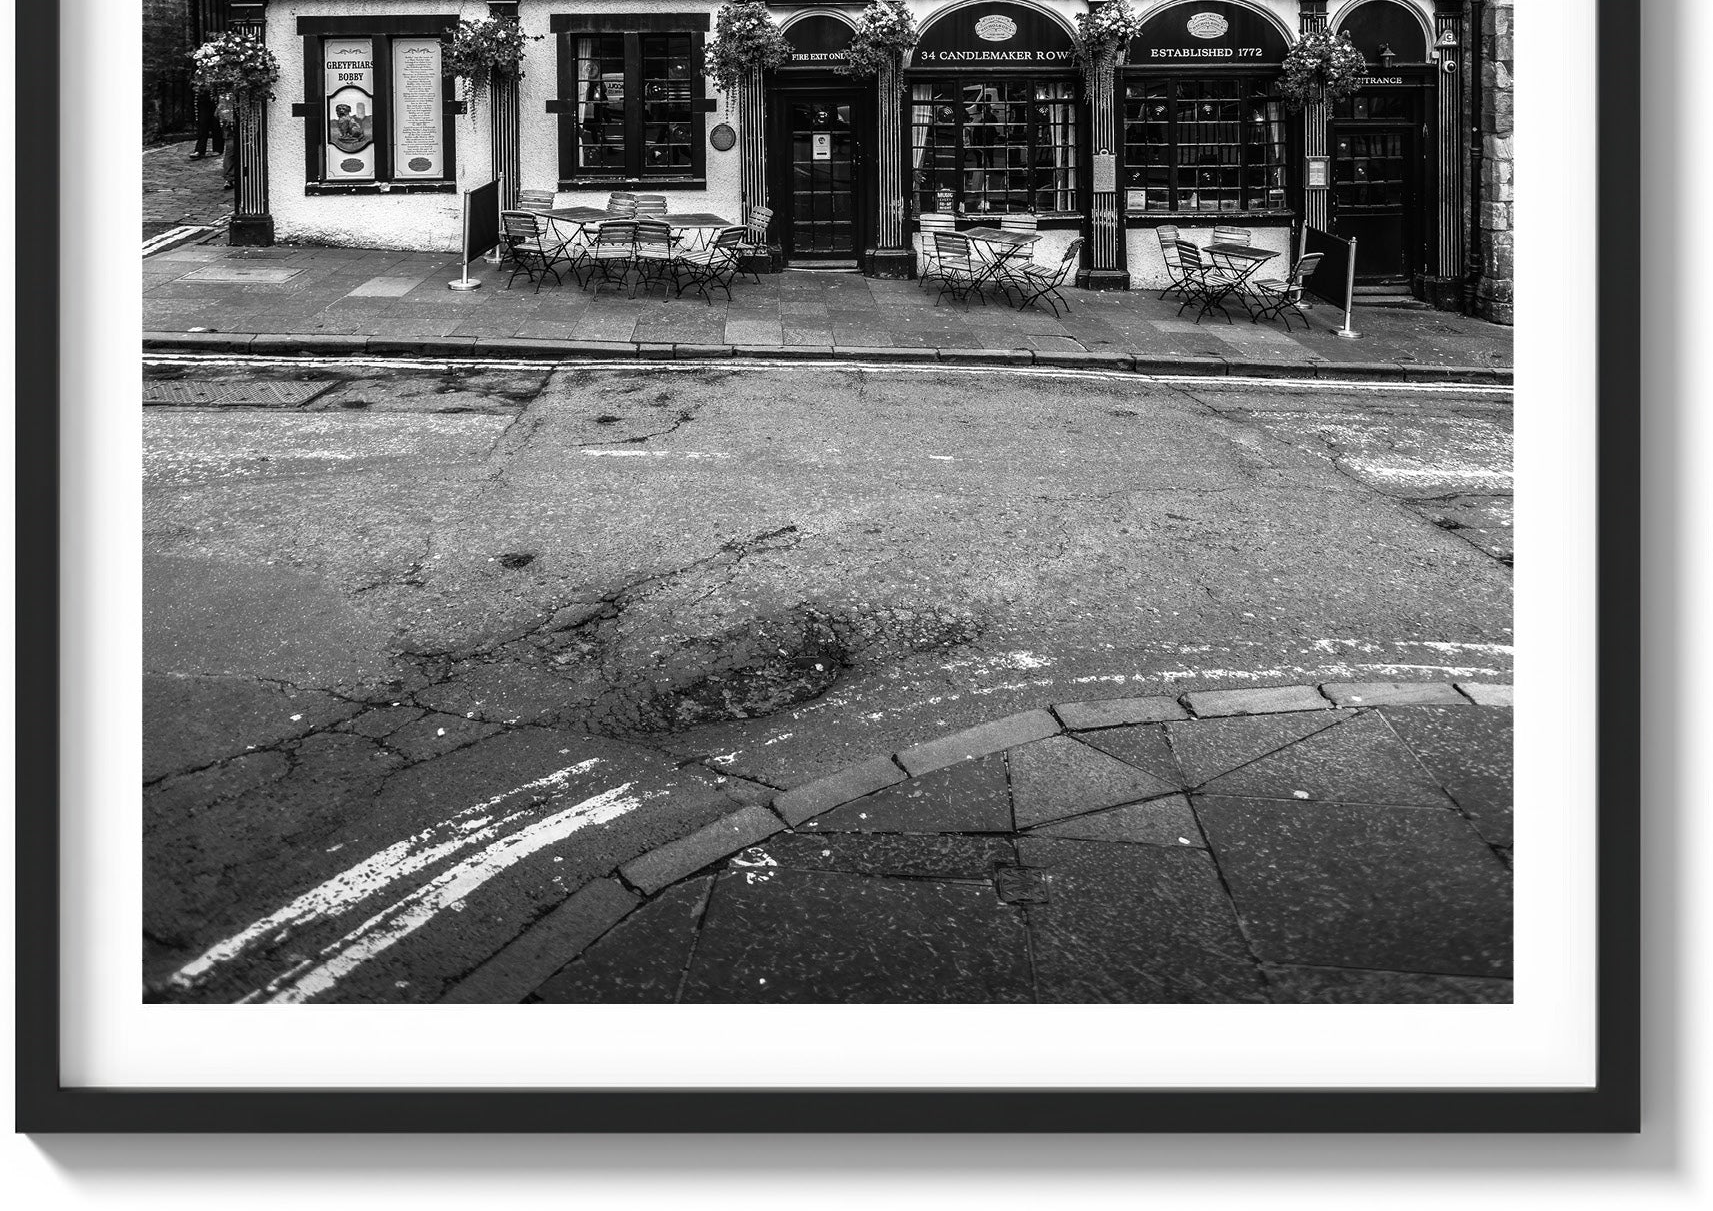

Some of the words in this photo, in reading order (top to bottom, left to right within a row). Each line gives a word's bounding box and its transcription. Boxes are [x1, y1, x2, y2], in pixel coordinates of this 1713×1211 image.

[791, 53, 809, 61] FIRE
[829, 52, 846, 60] ONL
[921, 51, 936, 60] 34
[939, 51, 1032, 60] CANDLEMAKER
[1036, 51, 1069, 60] ROW
[1150, 48, 1233, 57] ESTABLISHED
[1238, 48, 1263, 57] 1772
[326, 60, 374, 70] GREYFRIARS
[338, 72, 364, 81] BOBBY
